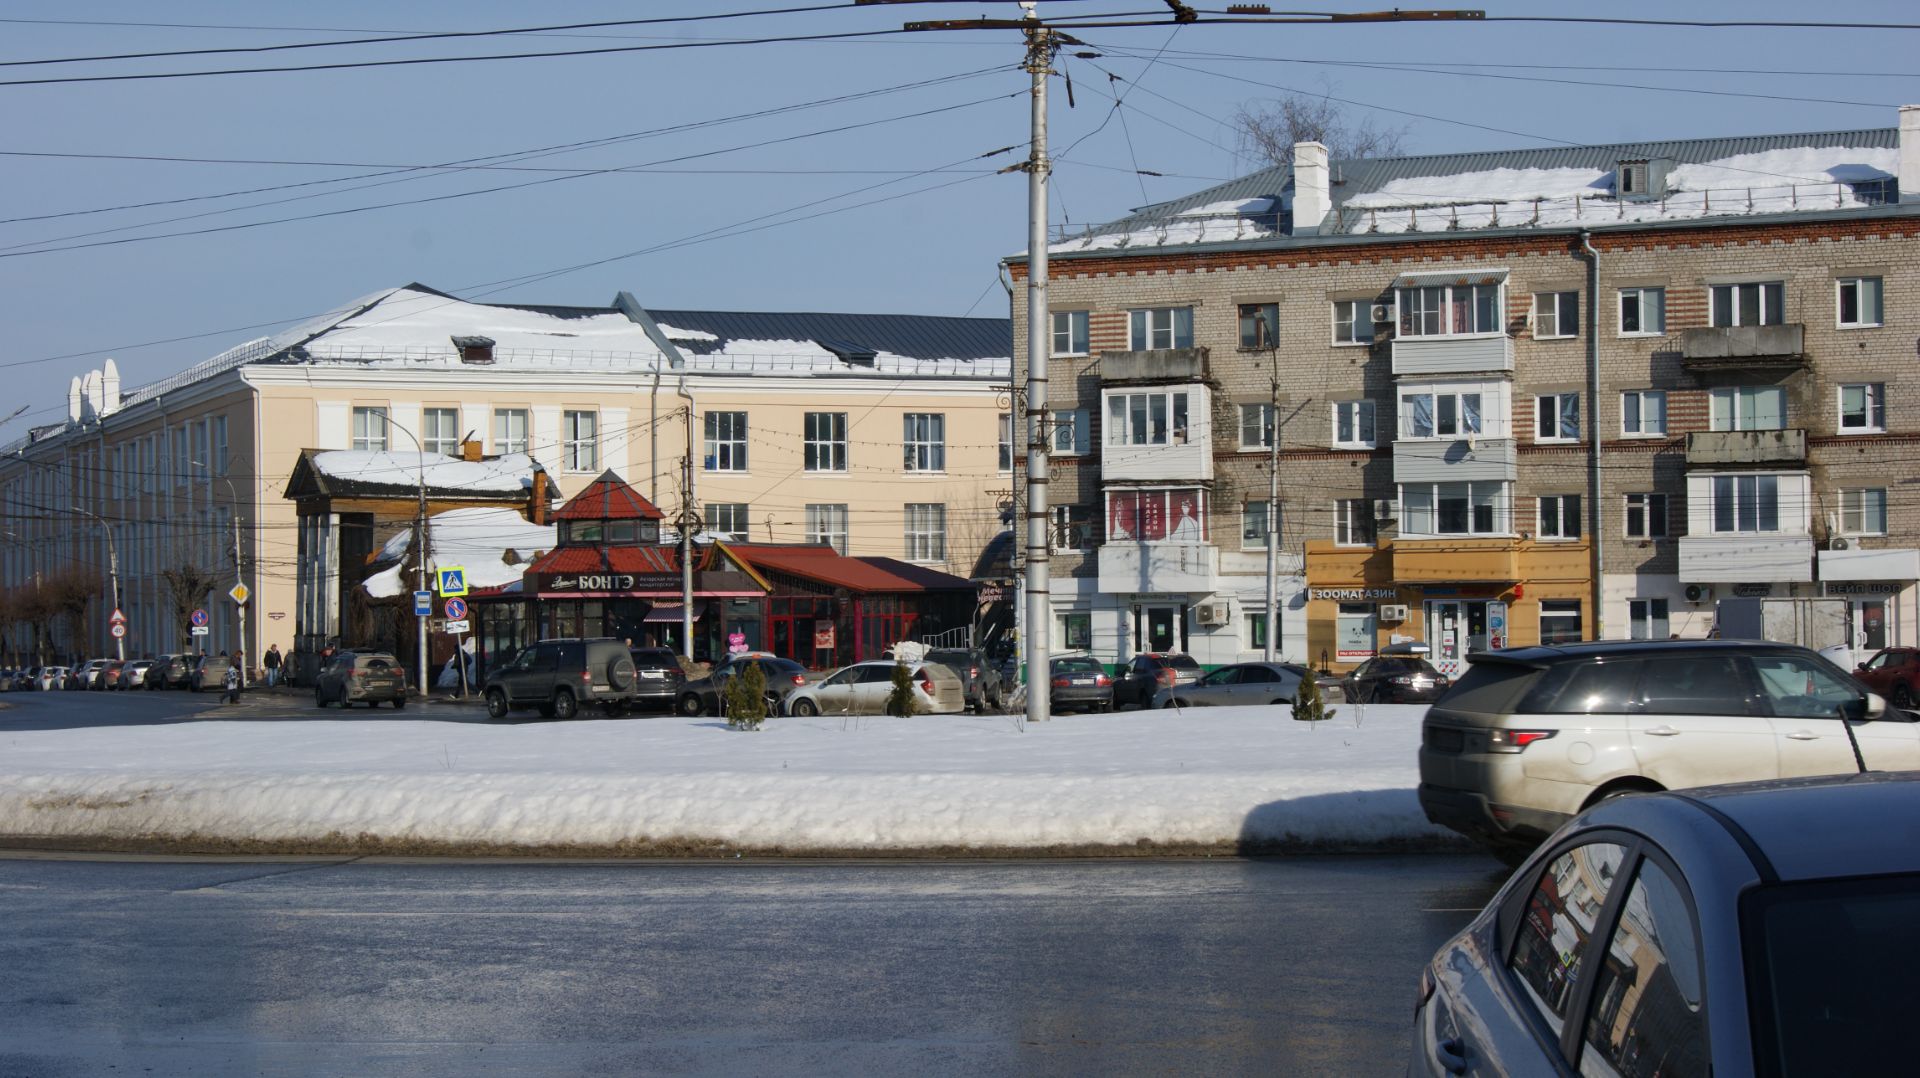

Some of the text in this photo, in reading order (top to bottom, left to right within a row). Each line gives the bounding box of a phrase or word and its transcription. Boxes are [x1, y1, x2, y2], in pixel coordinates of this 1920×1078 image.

[579, 575, 634, 590] БОНТЭ
[1316, 589, 1396, 599] ЗООМАГАЗИН
[114, 626, 124, 634] 40
